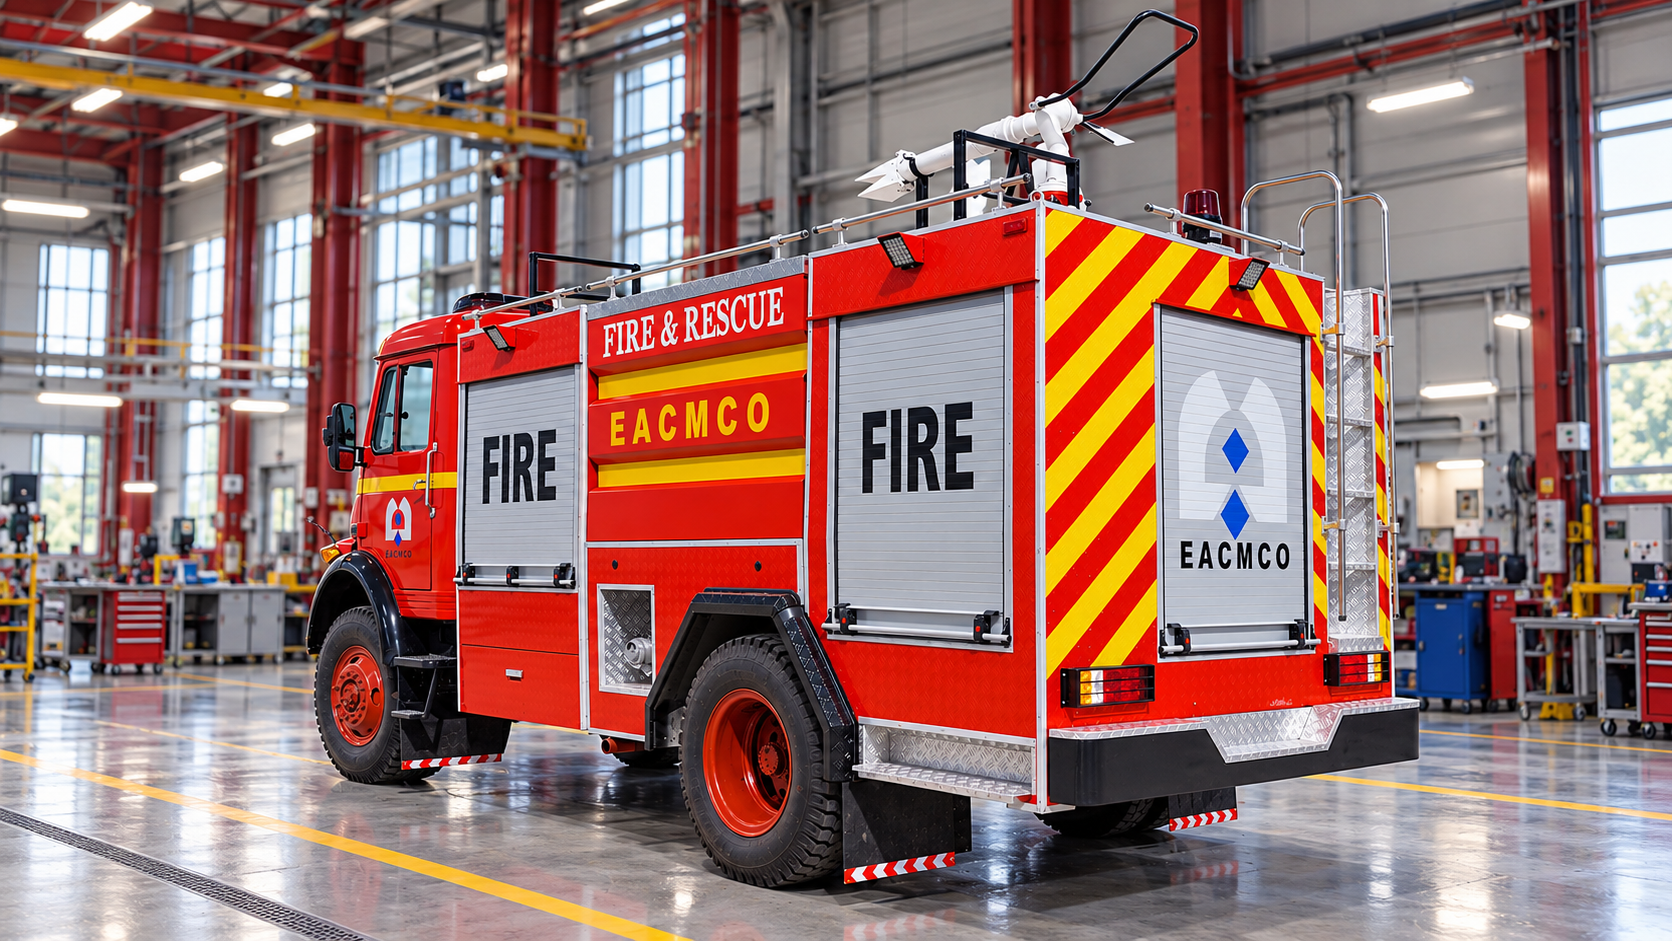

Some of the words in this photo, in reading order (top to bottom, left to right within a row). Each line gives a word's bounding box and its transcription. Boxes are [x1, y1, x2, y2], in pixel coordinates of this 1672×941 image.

[602, 314, 656, 359] FIRE
[660, 309, 679, 347] &
[683, 286, 785, 343] RESCUE
[610, 391, 770, 447] EACMCO
[862, 401, 974, 494] FIRE
[482, 428, 557, 505] FIRE
[1180, 540, 1290, 570] EACMCO
